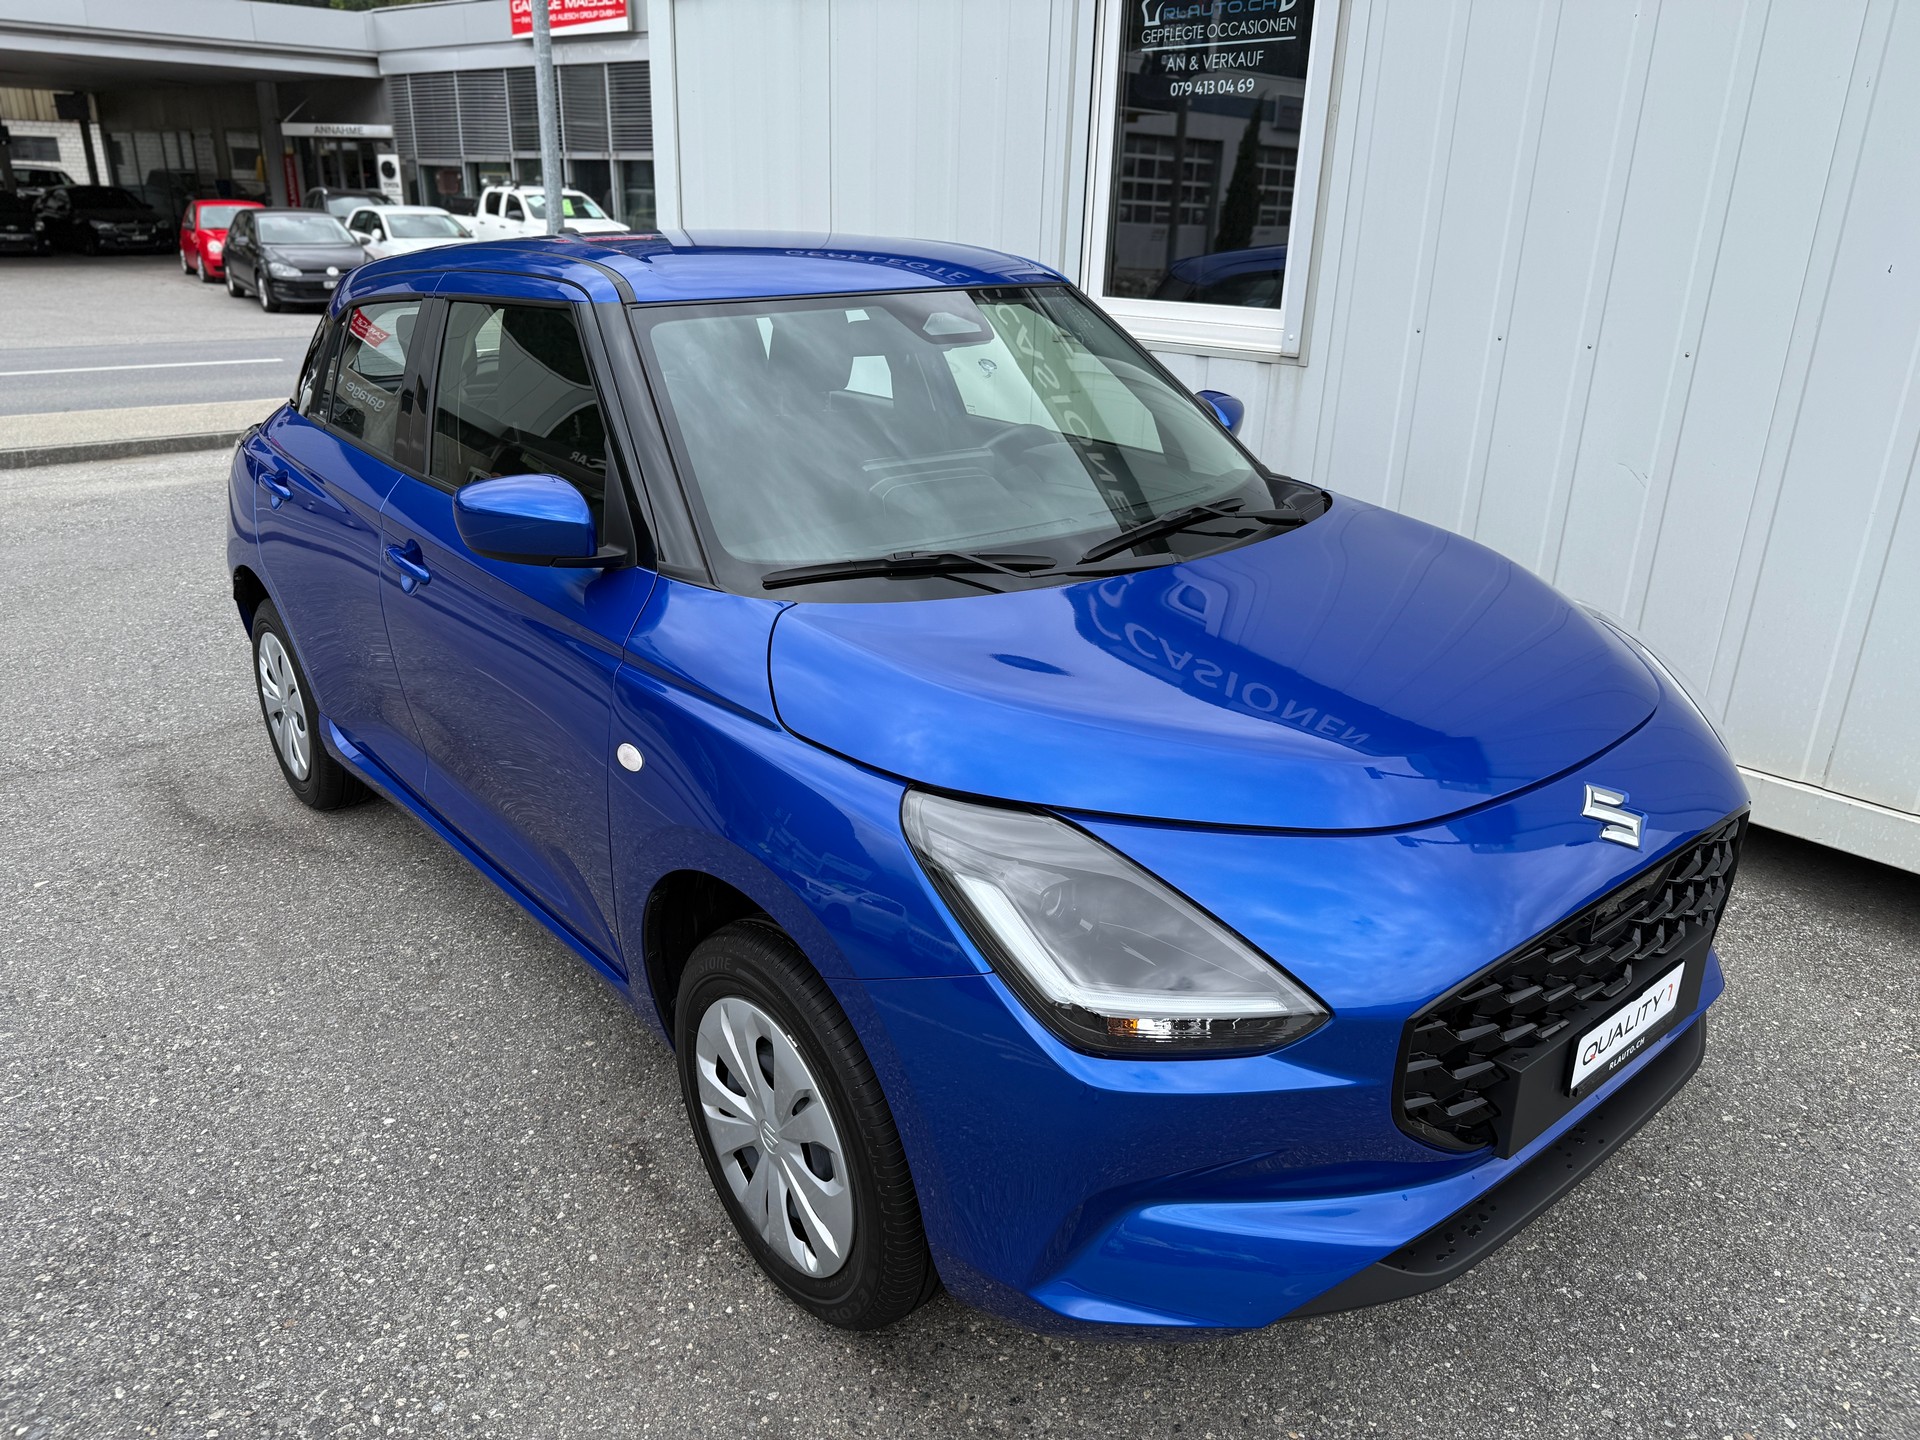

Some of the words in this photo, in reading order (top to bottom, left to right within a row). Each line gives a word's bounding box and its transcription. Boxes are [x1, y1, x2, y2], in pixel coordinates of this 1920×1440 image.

[512, 0, 562, 13] GAGE
[1141, 25, 1204, 44] GEPFLEGTE
[1206, 16, 1297, 39] OCCASIONEN
[1165, 56, 1186, 72] AN
[1189, 56, 1199, 71] &
[1203, 50, 1264, 69] VERKAUF
[1170, 82, 1192, 97] 079
[1194, 80, 1215, 95] 413
[1217, 79, 1234, 94] 04
[1237, 78, 1255, 93] 69
[314, 126, 365, 136] ANNAHME
[1582, 988, 1665, 1066] QUALITY
[1608, 1037, 1646, 1070] RLAUTO.CH
